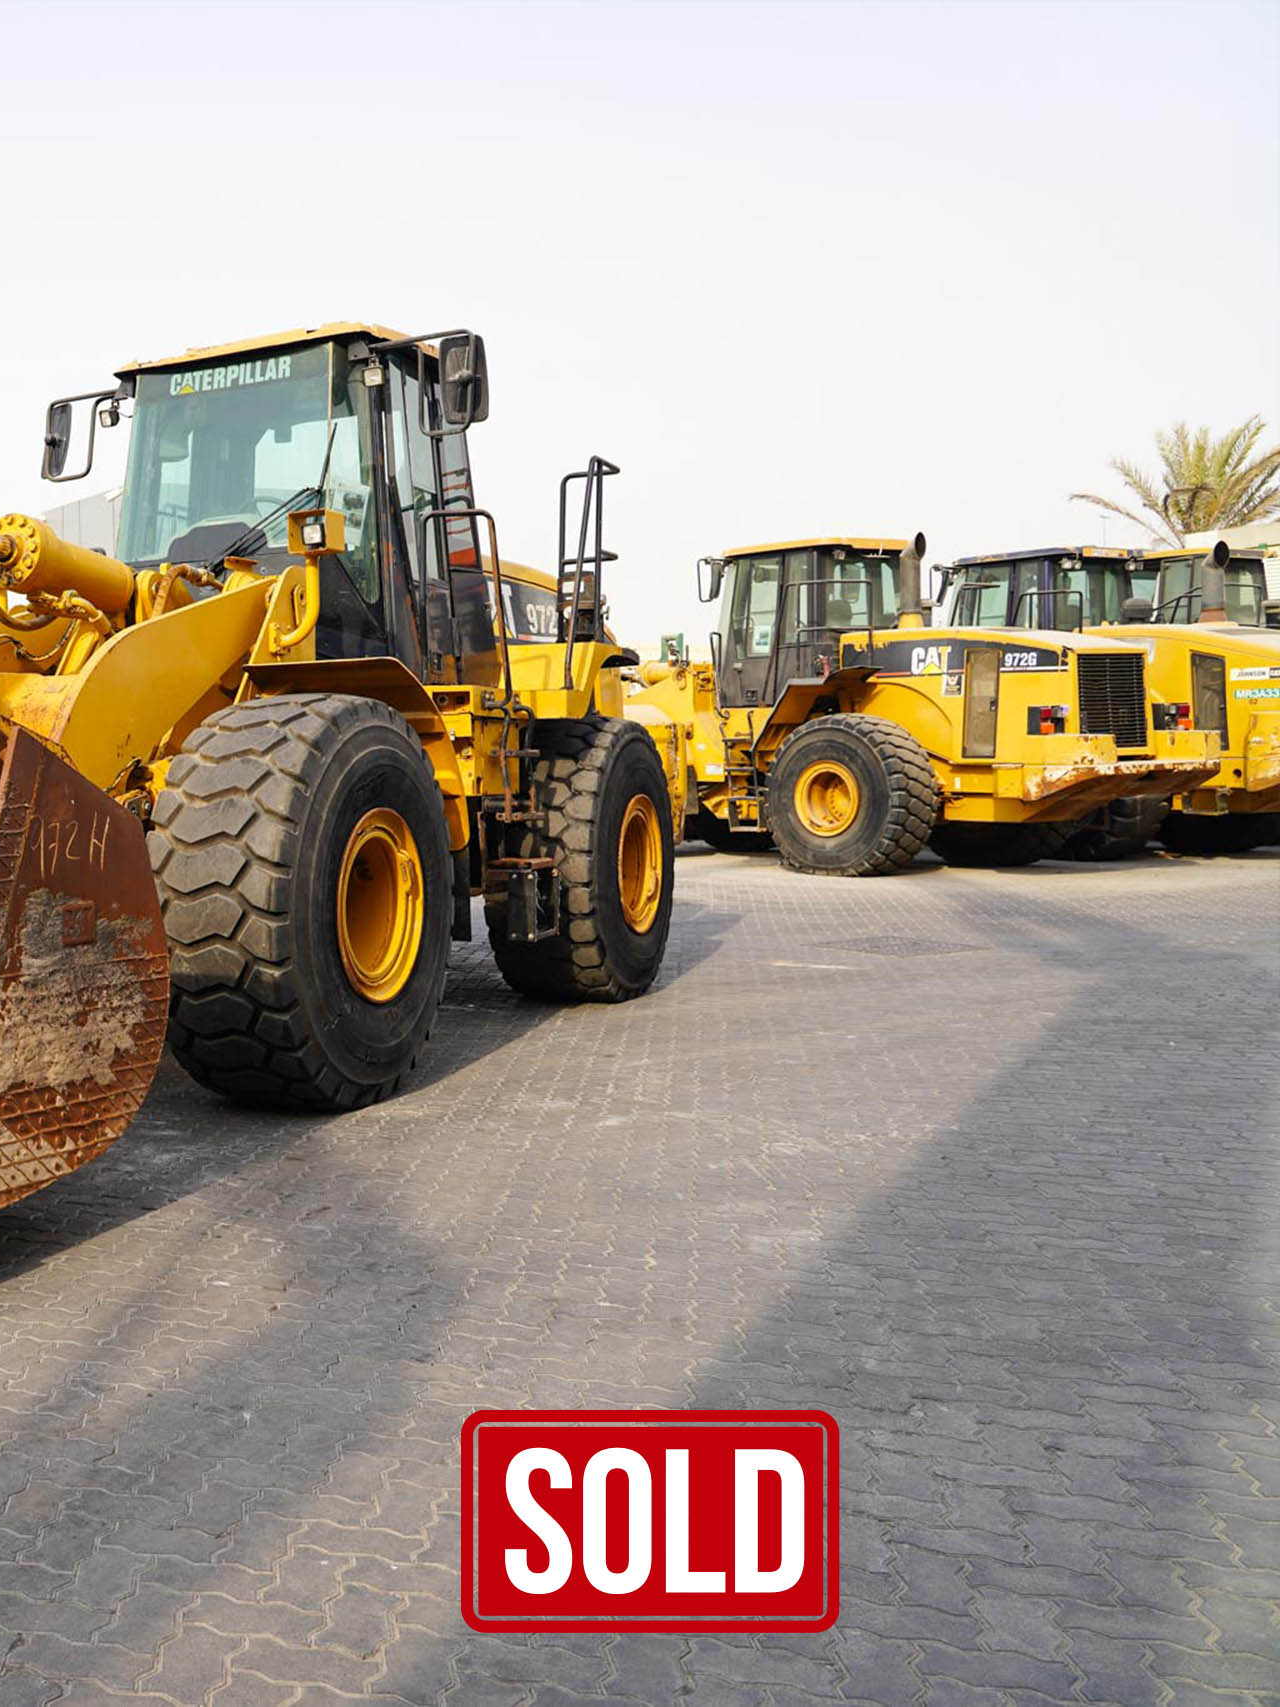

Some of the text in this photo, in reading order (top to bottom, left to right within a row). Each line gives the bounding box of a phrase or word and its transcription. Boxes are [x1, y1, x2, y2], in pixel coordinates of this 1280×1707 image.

[170, 355, 292, 396] CATERPILLAR
[526, 603, 559, 634] 972
[911, 646, 952, 675] CAT
[1004, 652, 1038, 667] 972G
